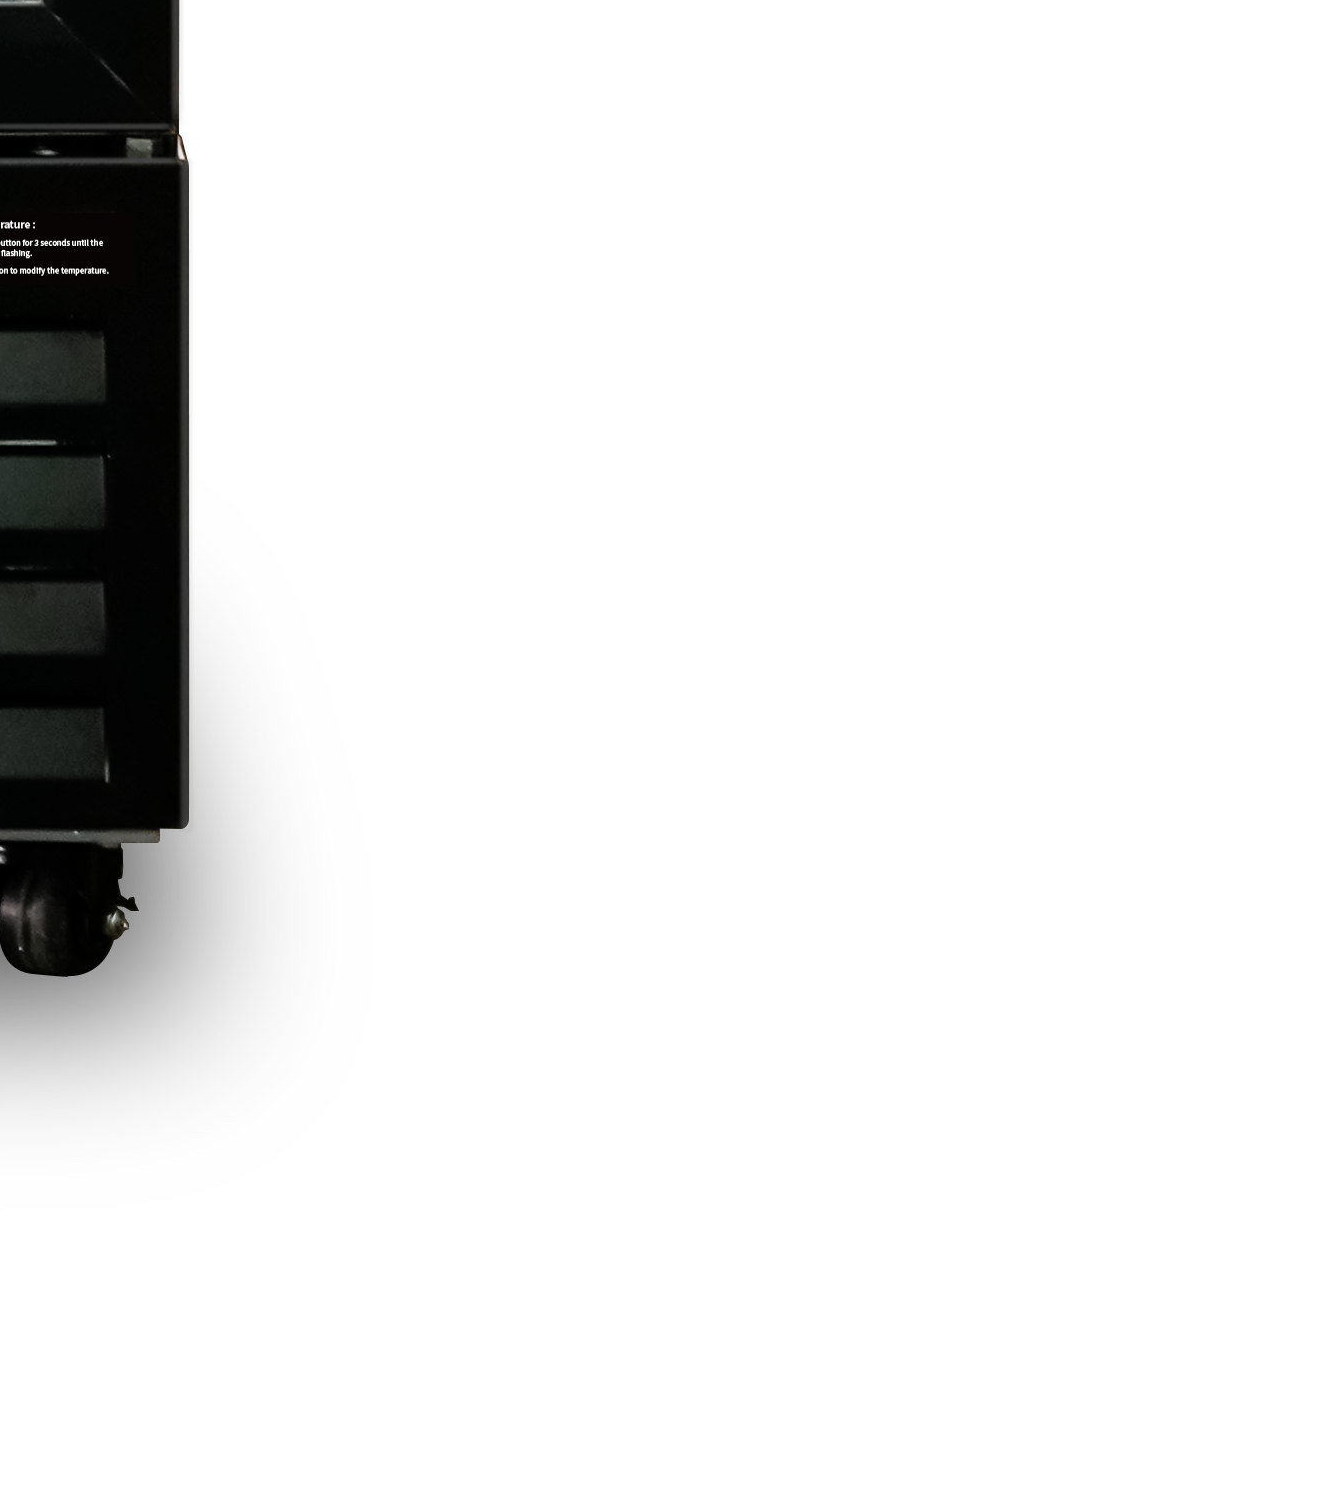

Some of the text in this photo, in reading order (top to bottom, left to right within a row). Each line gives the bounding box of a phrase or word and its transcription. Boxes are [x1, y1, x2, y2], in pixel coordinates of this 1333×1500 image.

[22, 239, 33, 247] for
[34, 239, 40, 247] 3
[40, 239, 71, 247] seconds
[71, 239, 90, 247] until
[90, 239, 104, 247] the
[1, 249, 33, 259] flashing.
[10, 267, 19, 275] to
[20, 266, 46, 276] modify
[47, 267, 60, 275] the
[61, 267, 110, 276] temperature.
